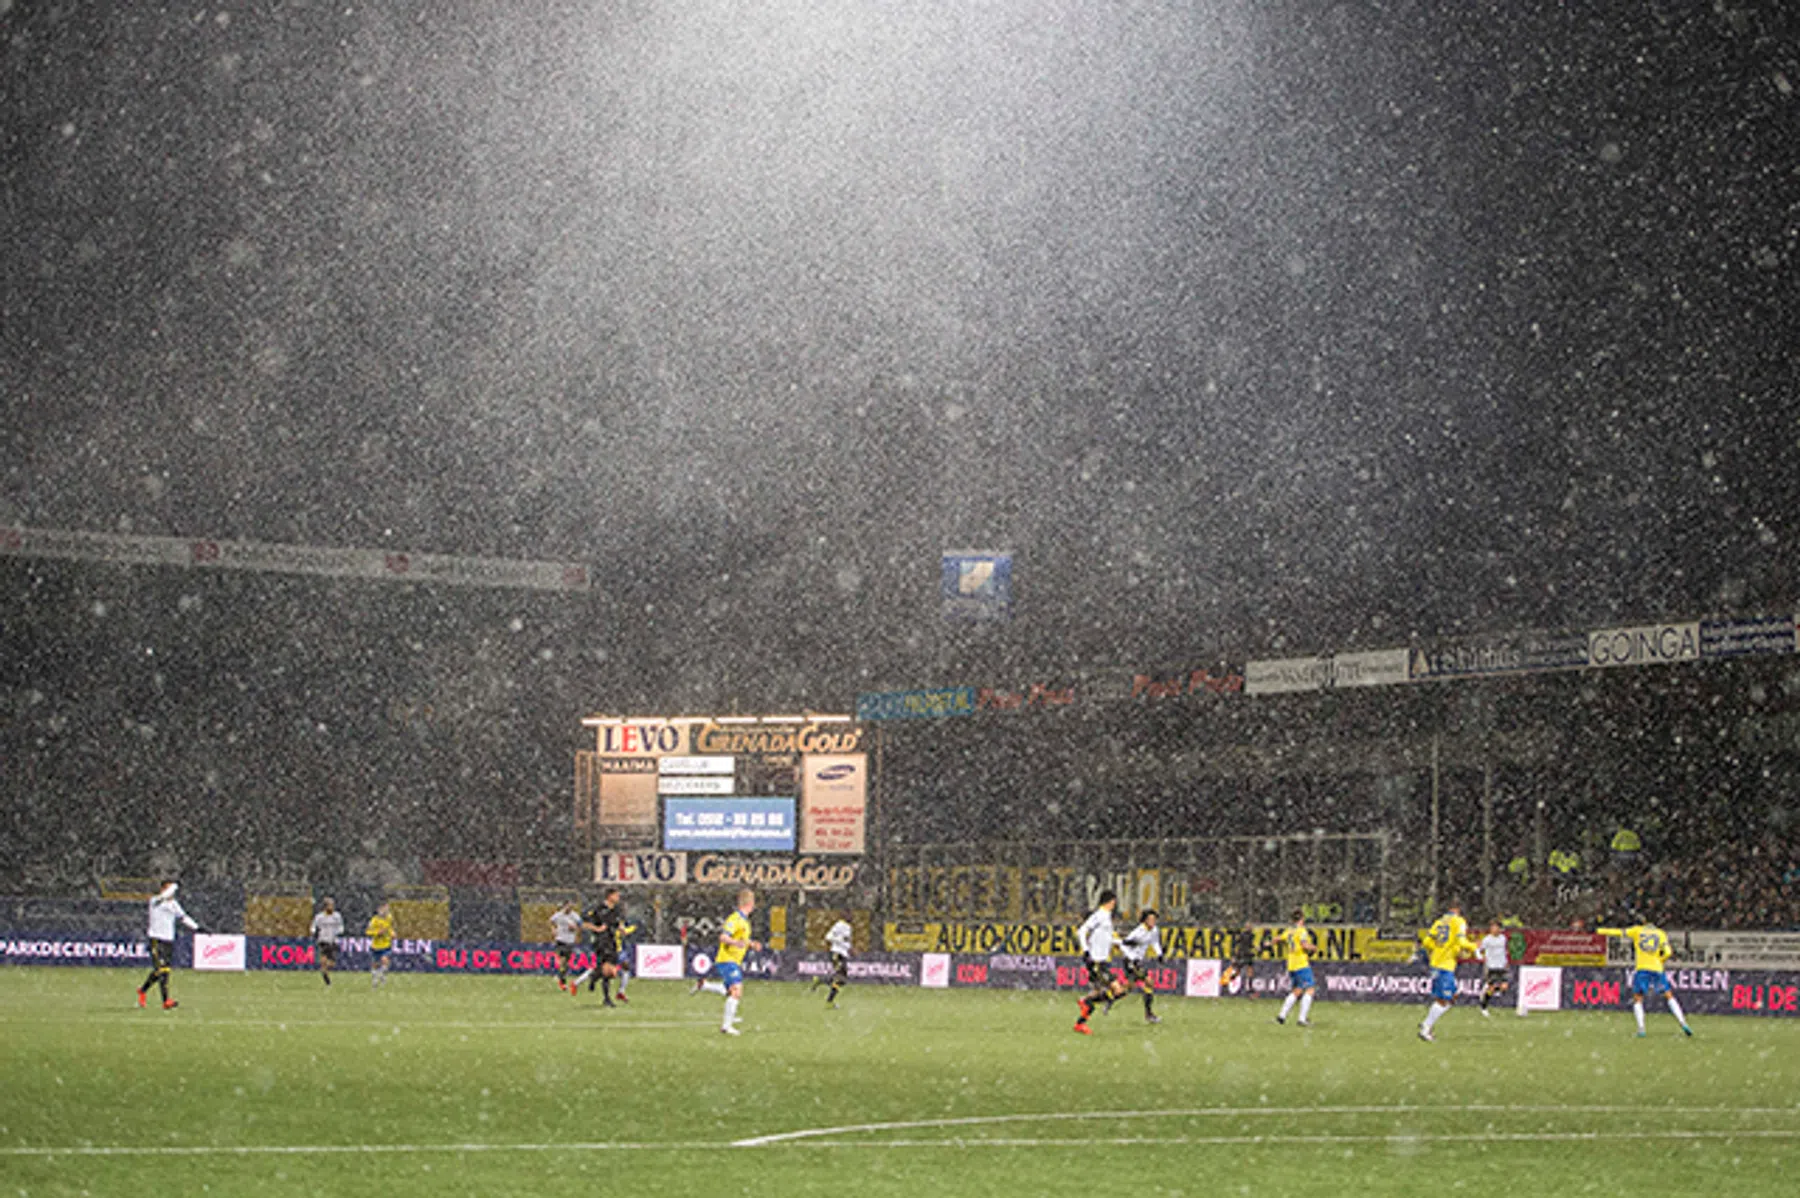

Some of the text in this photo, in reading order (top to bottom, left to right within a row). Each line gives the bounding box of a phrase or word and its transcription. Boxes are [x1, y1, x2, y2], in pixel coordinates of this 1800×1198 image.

[1591, 627, 1696, 664] GOINGA
[604, 725, 679, 752] LEVO
[601, 854, 677, 882] LEVO
[262, 945, 314, 966] KOM
[436, 948, 465, 969] BIJ
[471, 950, 501, 970] DE
[958, 964, 987, 983] KOM
[1573, 979, 1620, 1005] KOM
[1732, 983, 1763, 1010] BIJ
[1768, 985, 1799, 1012] DE
